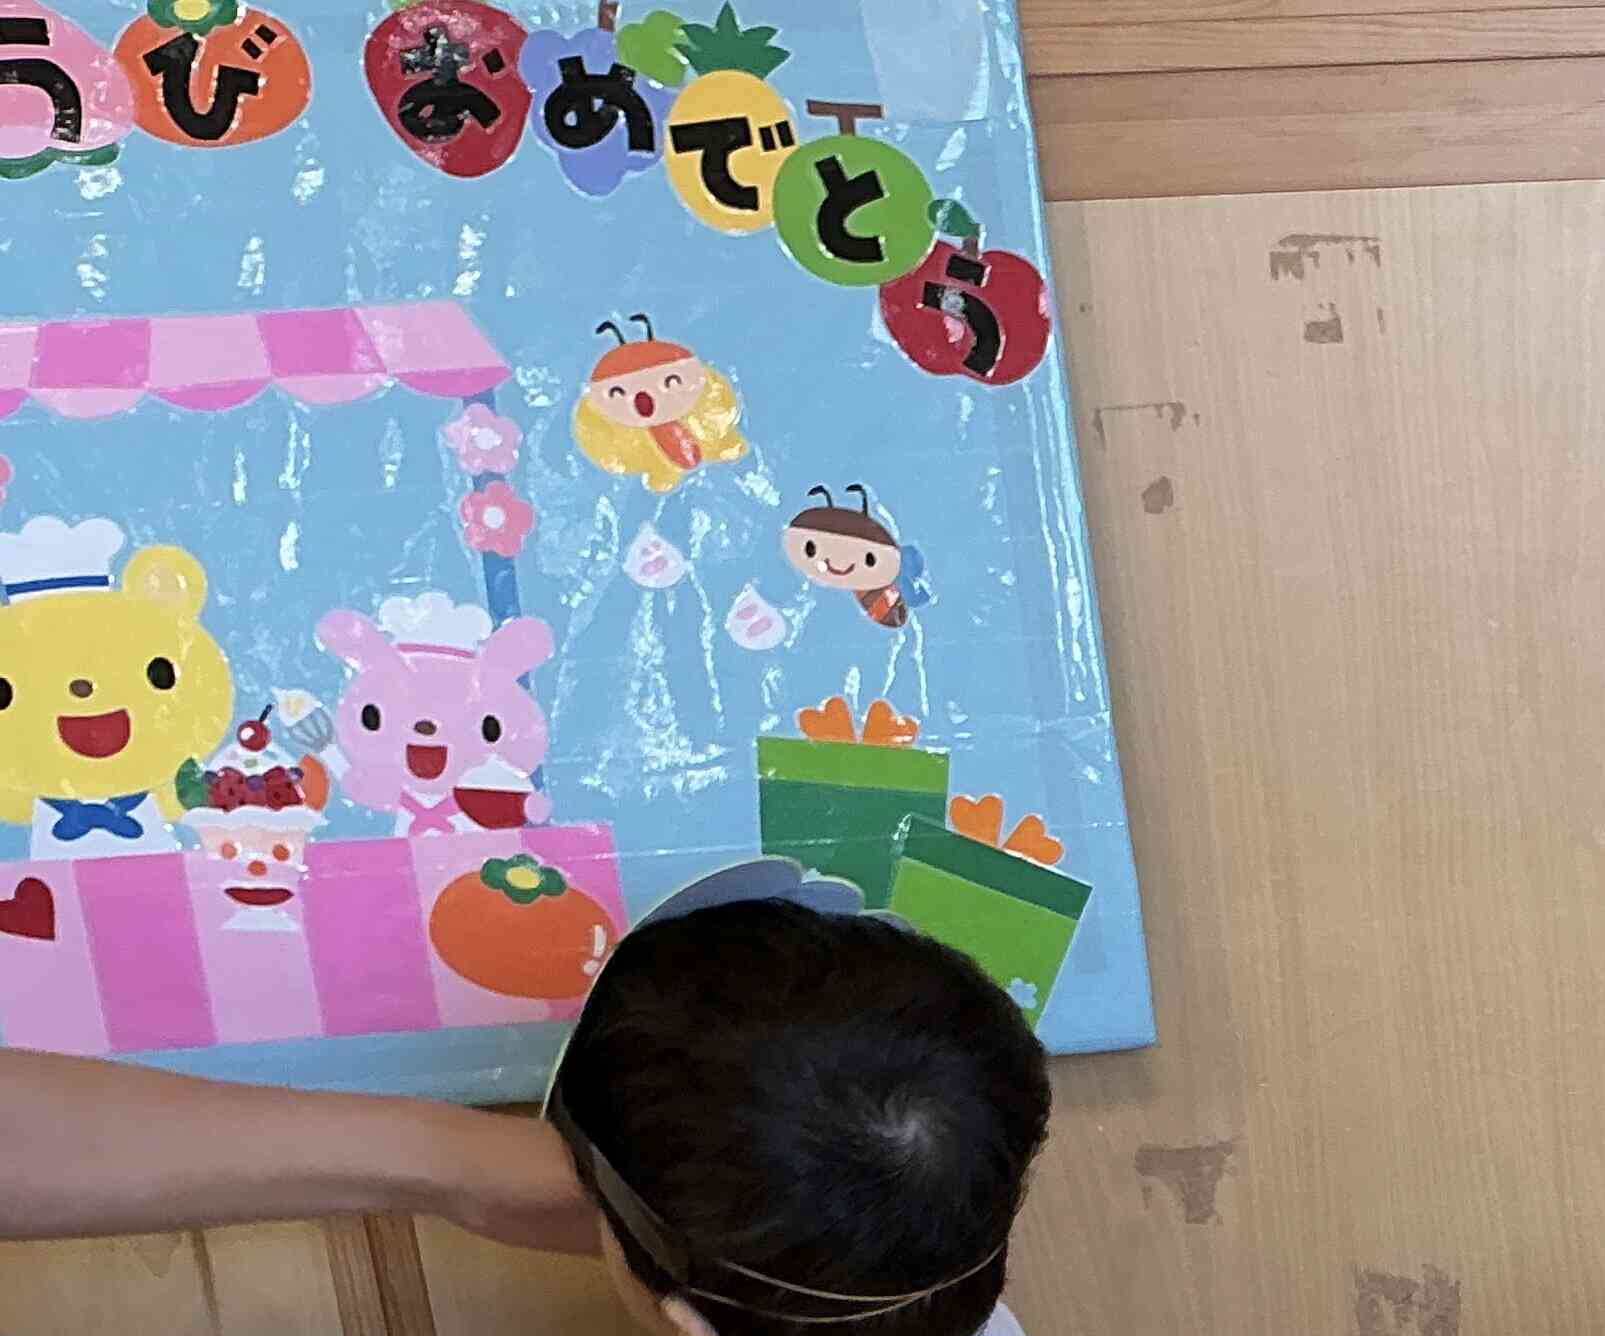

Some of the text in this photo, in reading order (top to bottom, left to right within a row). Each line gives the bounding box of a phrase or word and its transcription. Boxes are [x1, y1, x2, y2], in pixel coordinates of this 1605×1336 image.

[398, 25, 1006, 378] おめでとう
